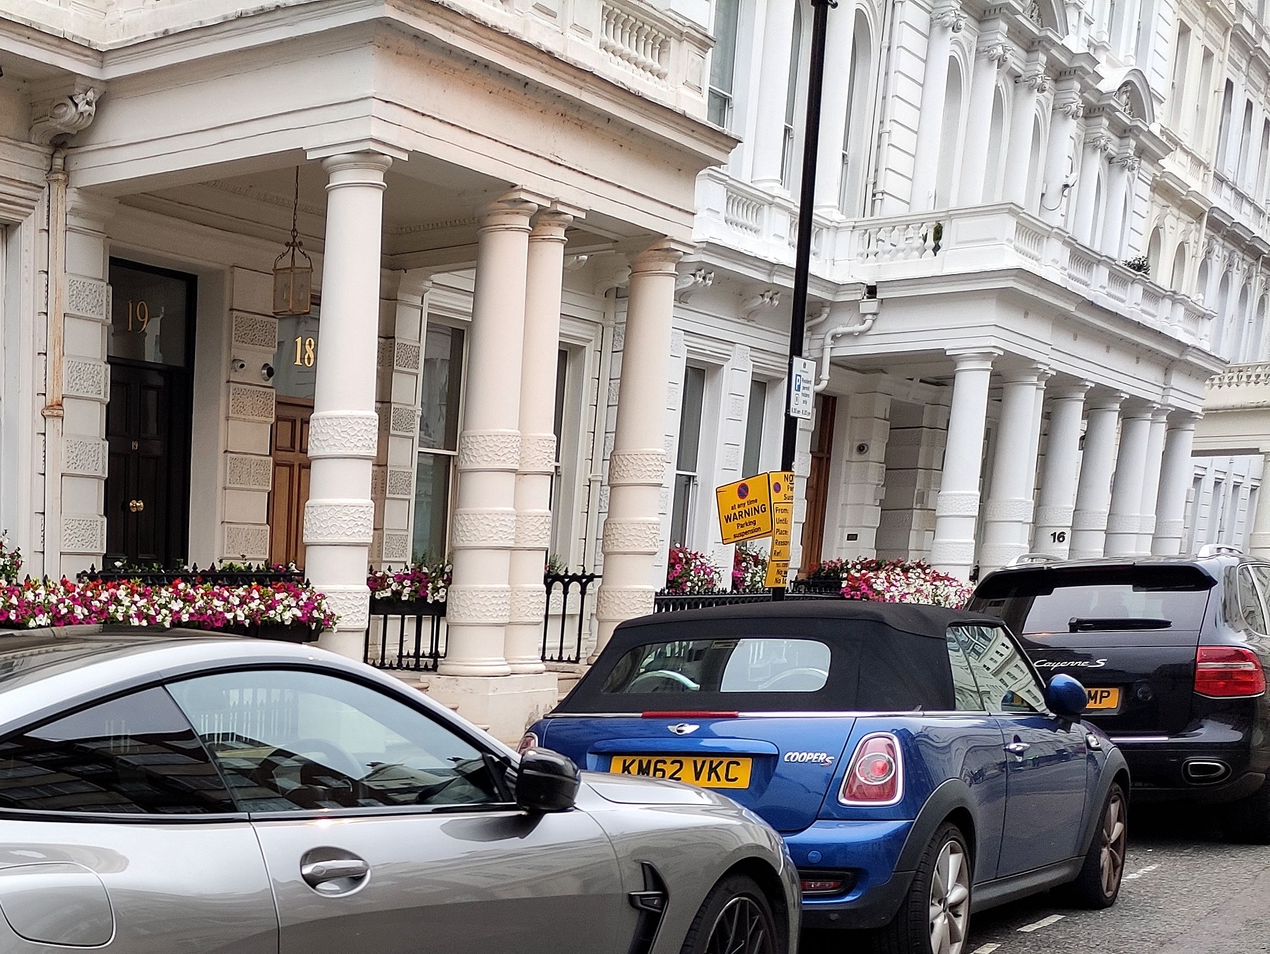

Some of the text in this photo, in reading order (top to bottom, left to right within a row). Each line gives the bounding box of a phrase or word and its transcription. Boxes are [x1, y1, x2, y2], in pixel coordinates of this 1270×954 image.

[128, 299, 149, 333] 19
[294, 337, 315, 367] 18
[724, 504, 766, 523] WARNING
[737, 520, 756, 529] Parking
[733, 527, 761, 538] suspension
[1050, 531, 1066, 543] 16
[1034, 659, 1107, 671] Cayenne S
[784, 751, 825, 763] COOPER
[622, 759, 741, 782] KM62 VKC
